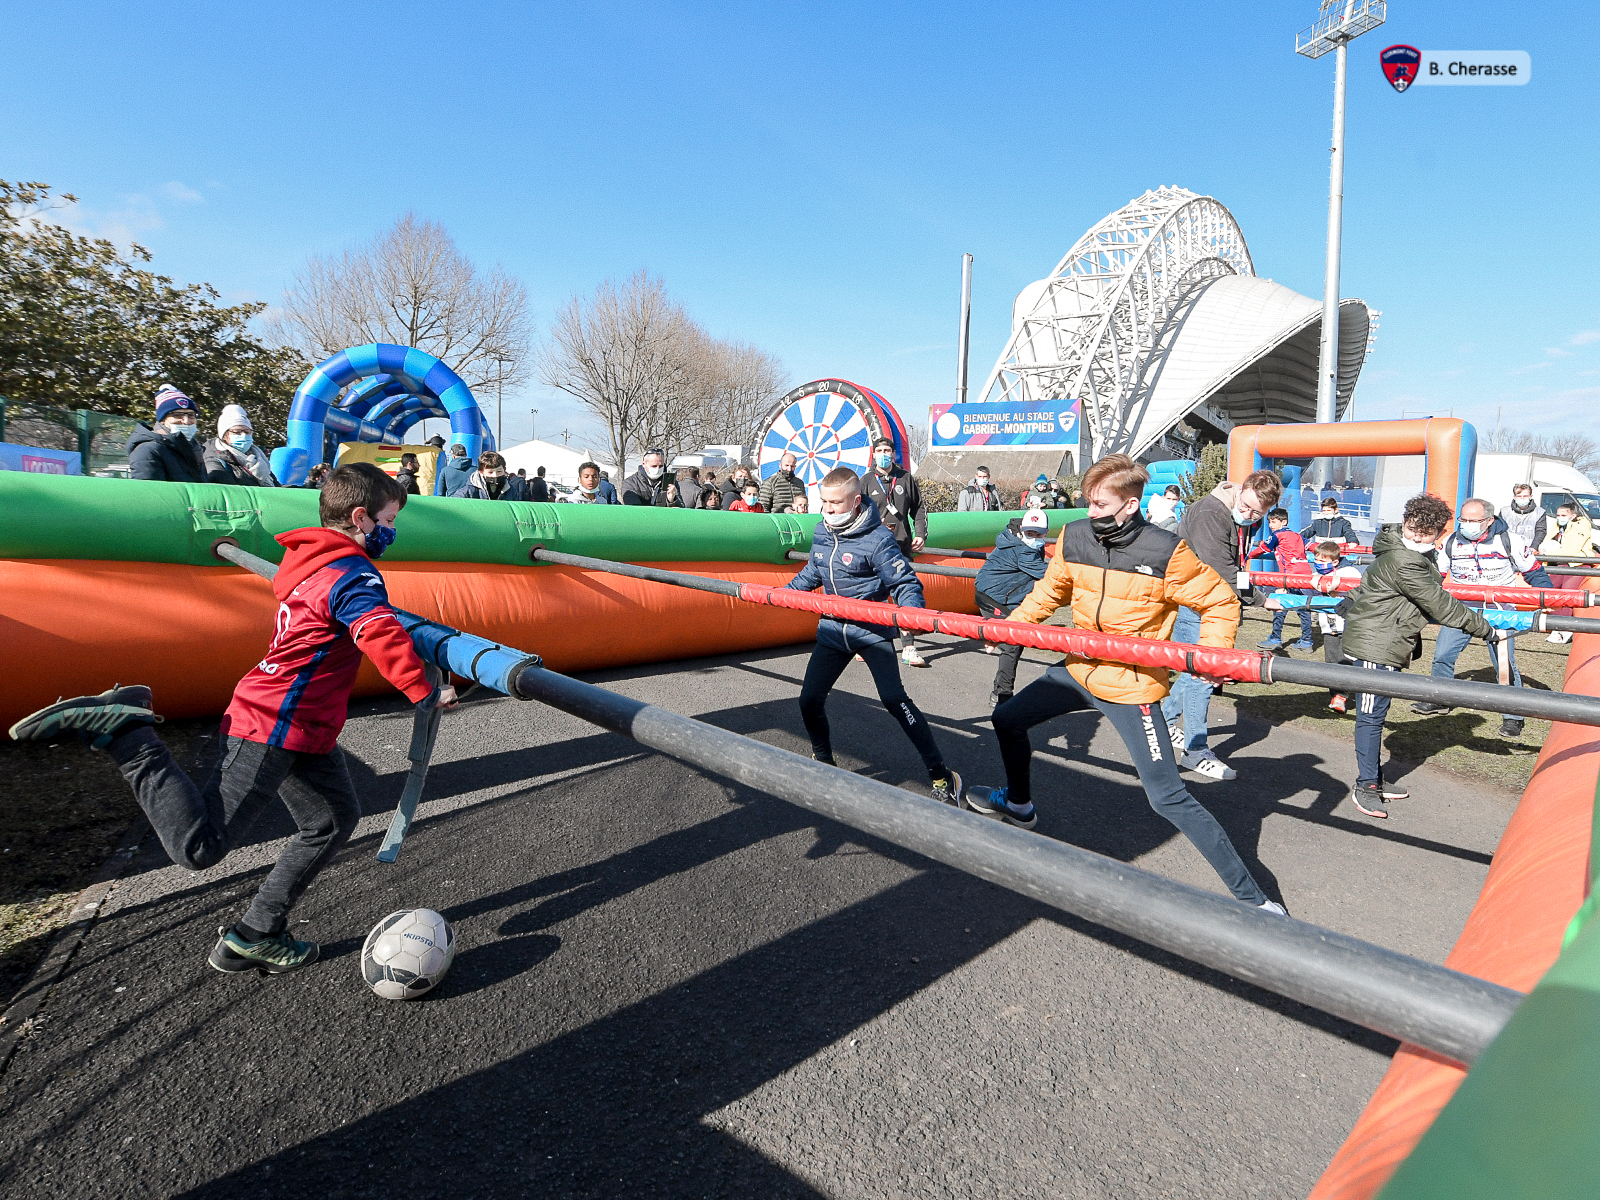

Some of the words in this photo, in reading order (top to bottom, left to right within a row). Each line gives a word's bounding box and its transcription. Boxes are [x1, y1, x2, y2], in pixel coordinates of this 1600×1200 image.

[798, 387, 805, 397] 5
[818, 381, 830, 392] 20
[836, 382, 843, 393] 1
[780, 395, 793, 409] 12
[852, 392, 863, 404] 18
[963, 412, 1011, 423] BIENVENUE
[1012, 412, 1025, 422] AU
[1027, 411, 1055, 422] STADE
[962, 423, 1055, 434] GABRIEL-MONTPIED
[1141, 715, 1163, 762] PATRICK
